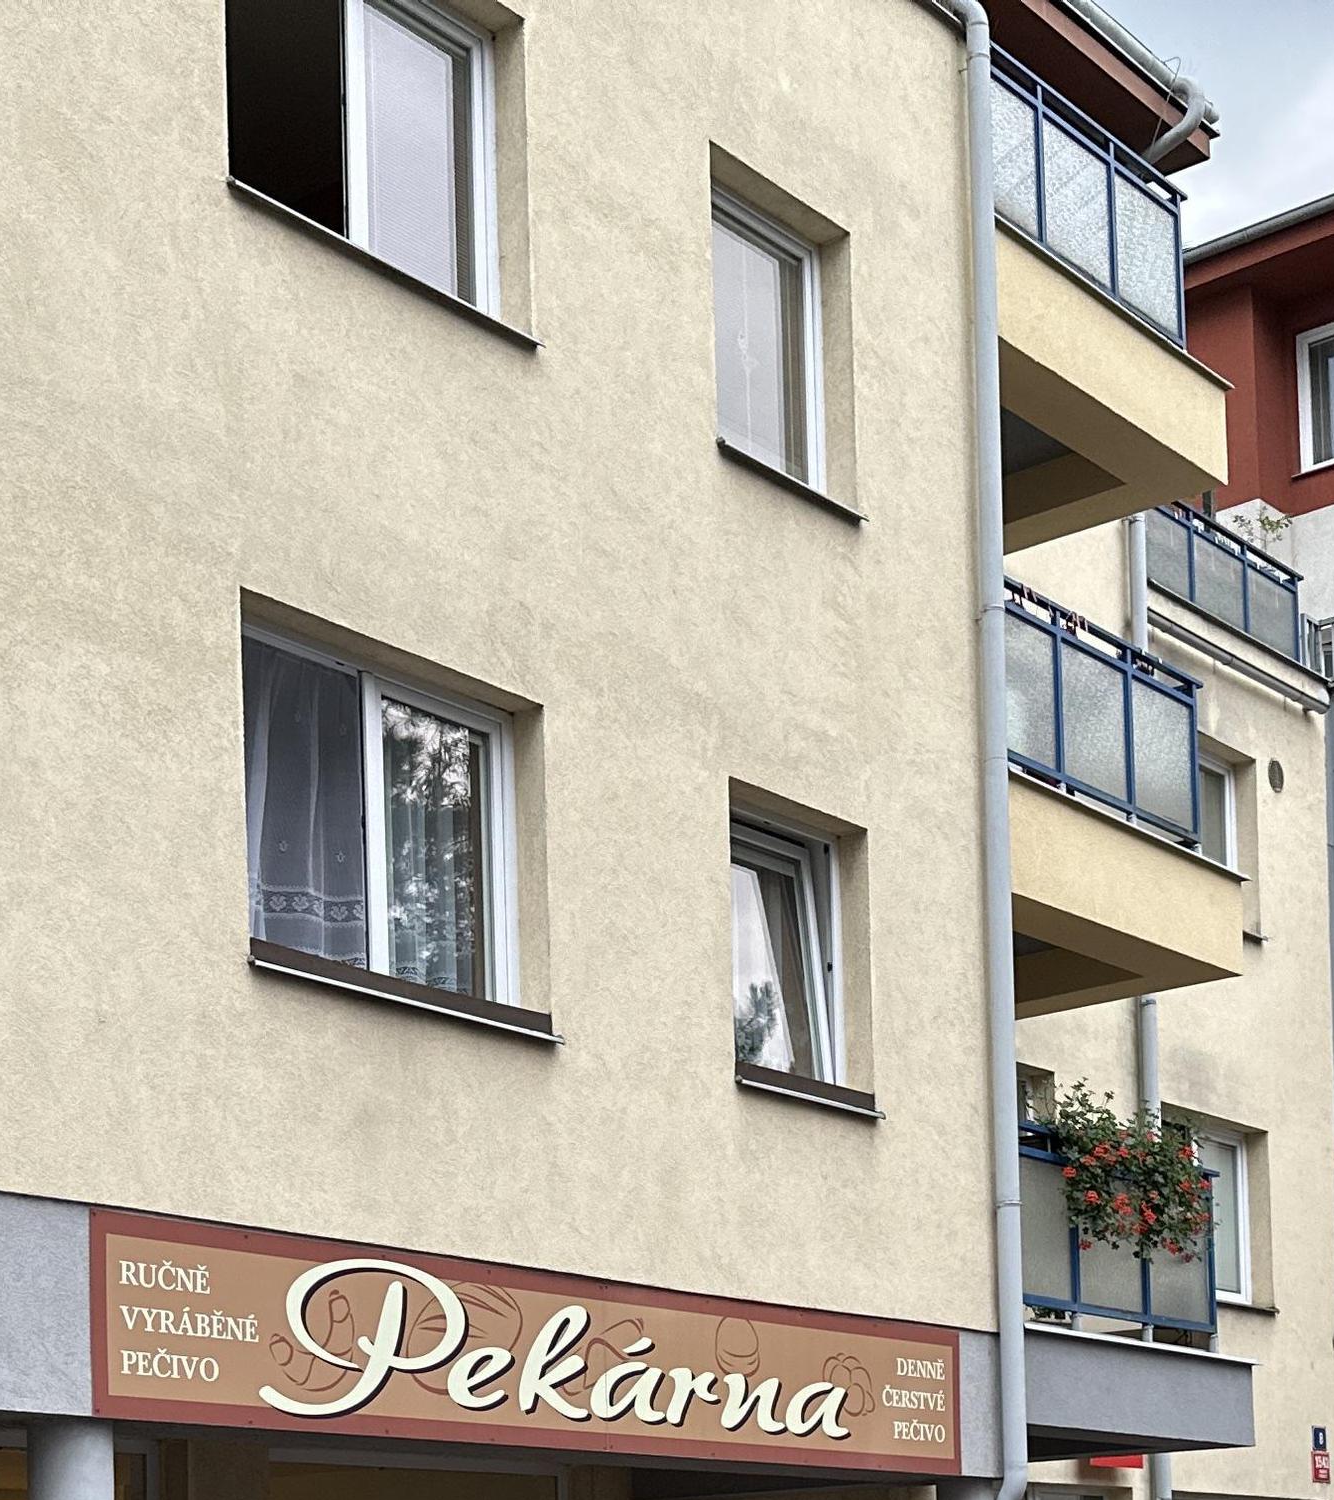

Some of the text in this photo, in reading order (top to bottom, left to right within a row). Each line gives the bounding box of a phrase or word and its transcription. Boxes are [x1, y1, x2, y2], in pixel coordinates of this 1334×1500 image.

[119, 1260, 211, 1295] RUČNĚ
[119, 1305, 259, 1343] VYRÁBĚNÉ
[120, 1347, 219, 1382] PEČIVO
[258, 1258, 851, 1440] Pekárna
[896, 1357, 945, 1380] DENNĚ
[881, 1384, 946, 1411] ČERSTVÉ
[893, 1419, 946, 1443] PEČIVO
